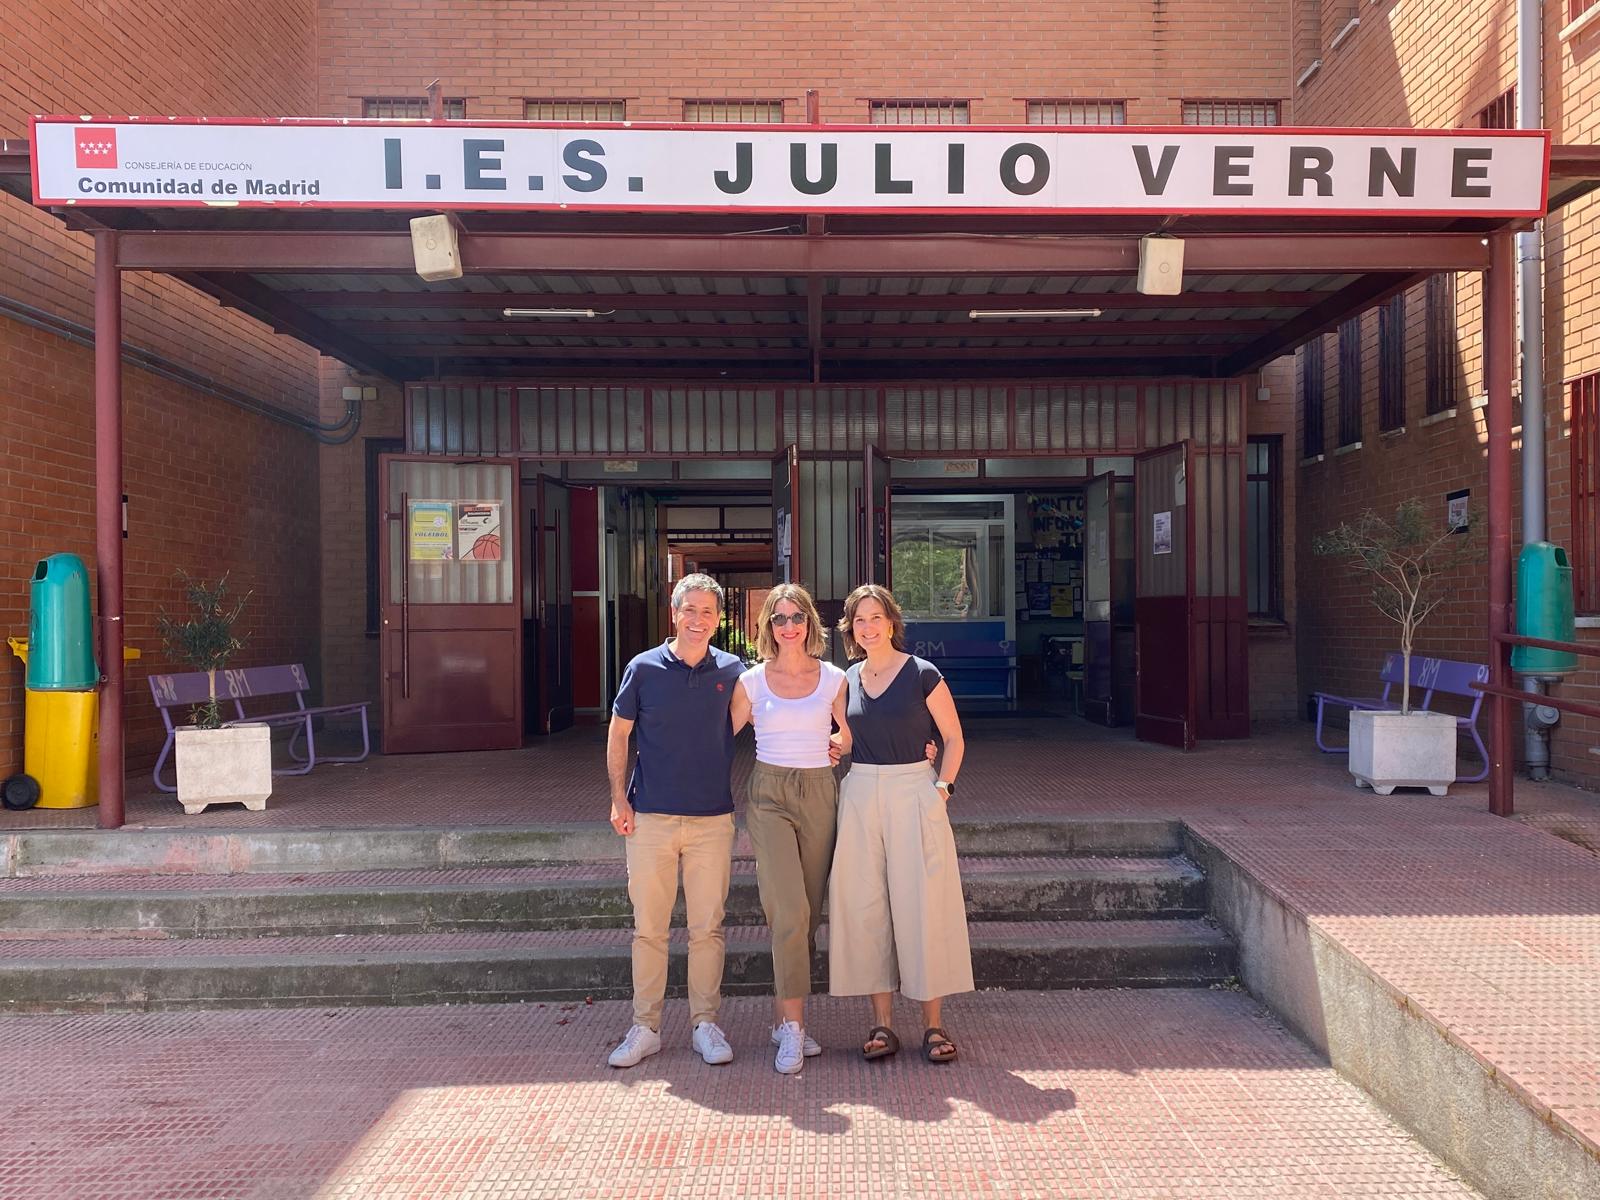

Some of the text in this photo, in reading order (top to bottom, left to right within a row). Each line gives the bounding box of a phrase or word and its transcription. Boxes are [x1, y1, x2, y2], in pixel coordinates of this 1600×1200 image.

[125, 161, 252, 171] CONSEJERÍA DE EDUCACIÓN
[384, 138, 1493, 198] I.E.S. JULIO VERNE
[78, 177, 321, 195] Comunidad de Madrid
[913, 641, 946, 657] 8M
[224, 669, 252, 698] 8M
[1417, 657, 1441, 689] 8M
